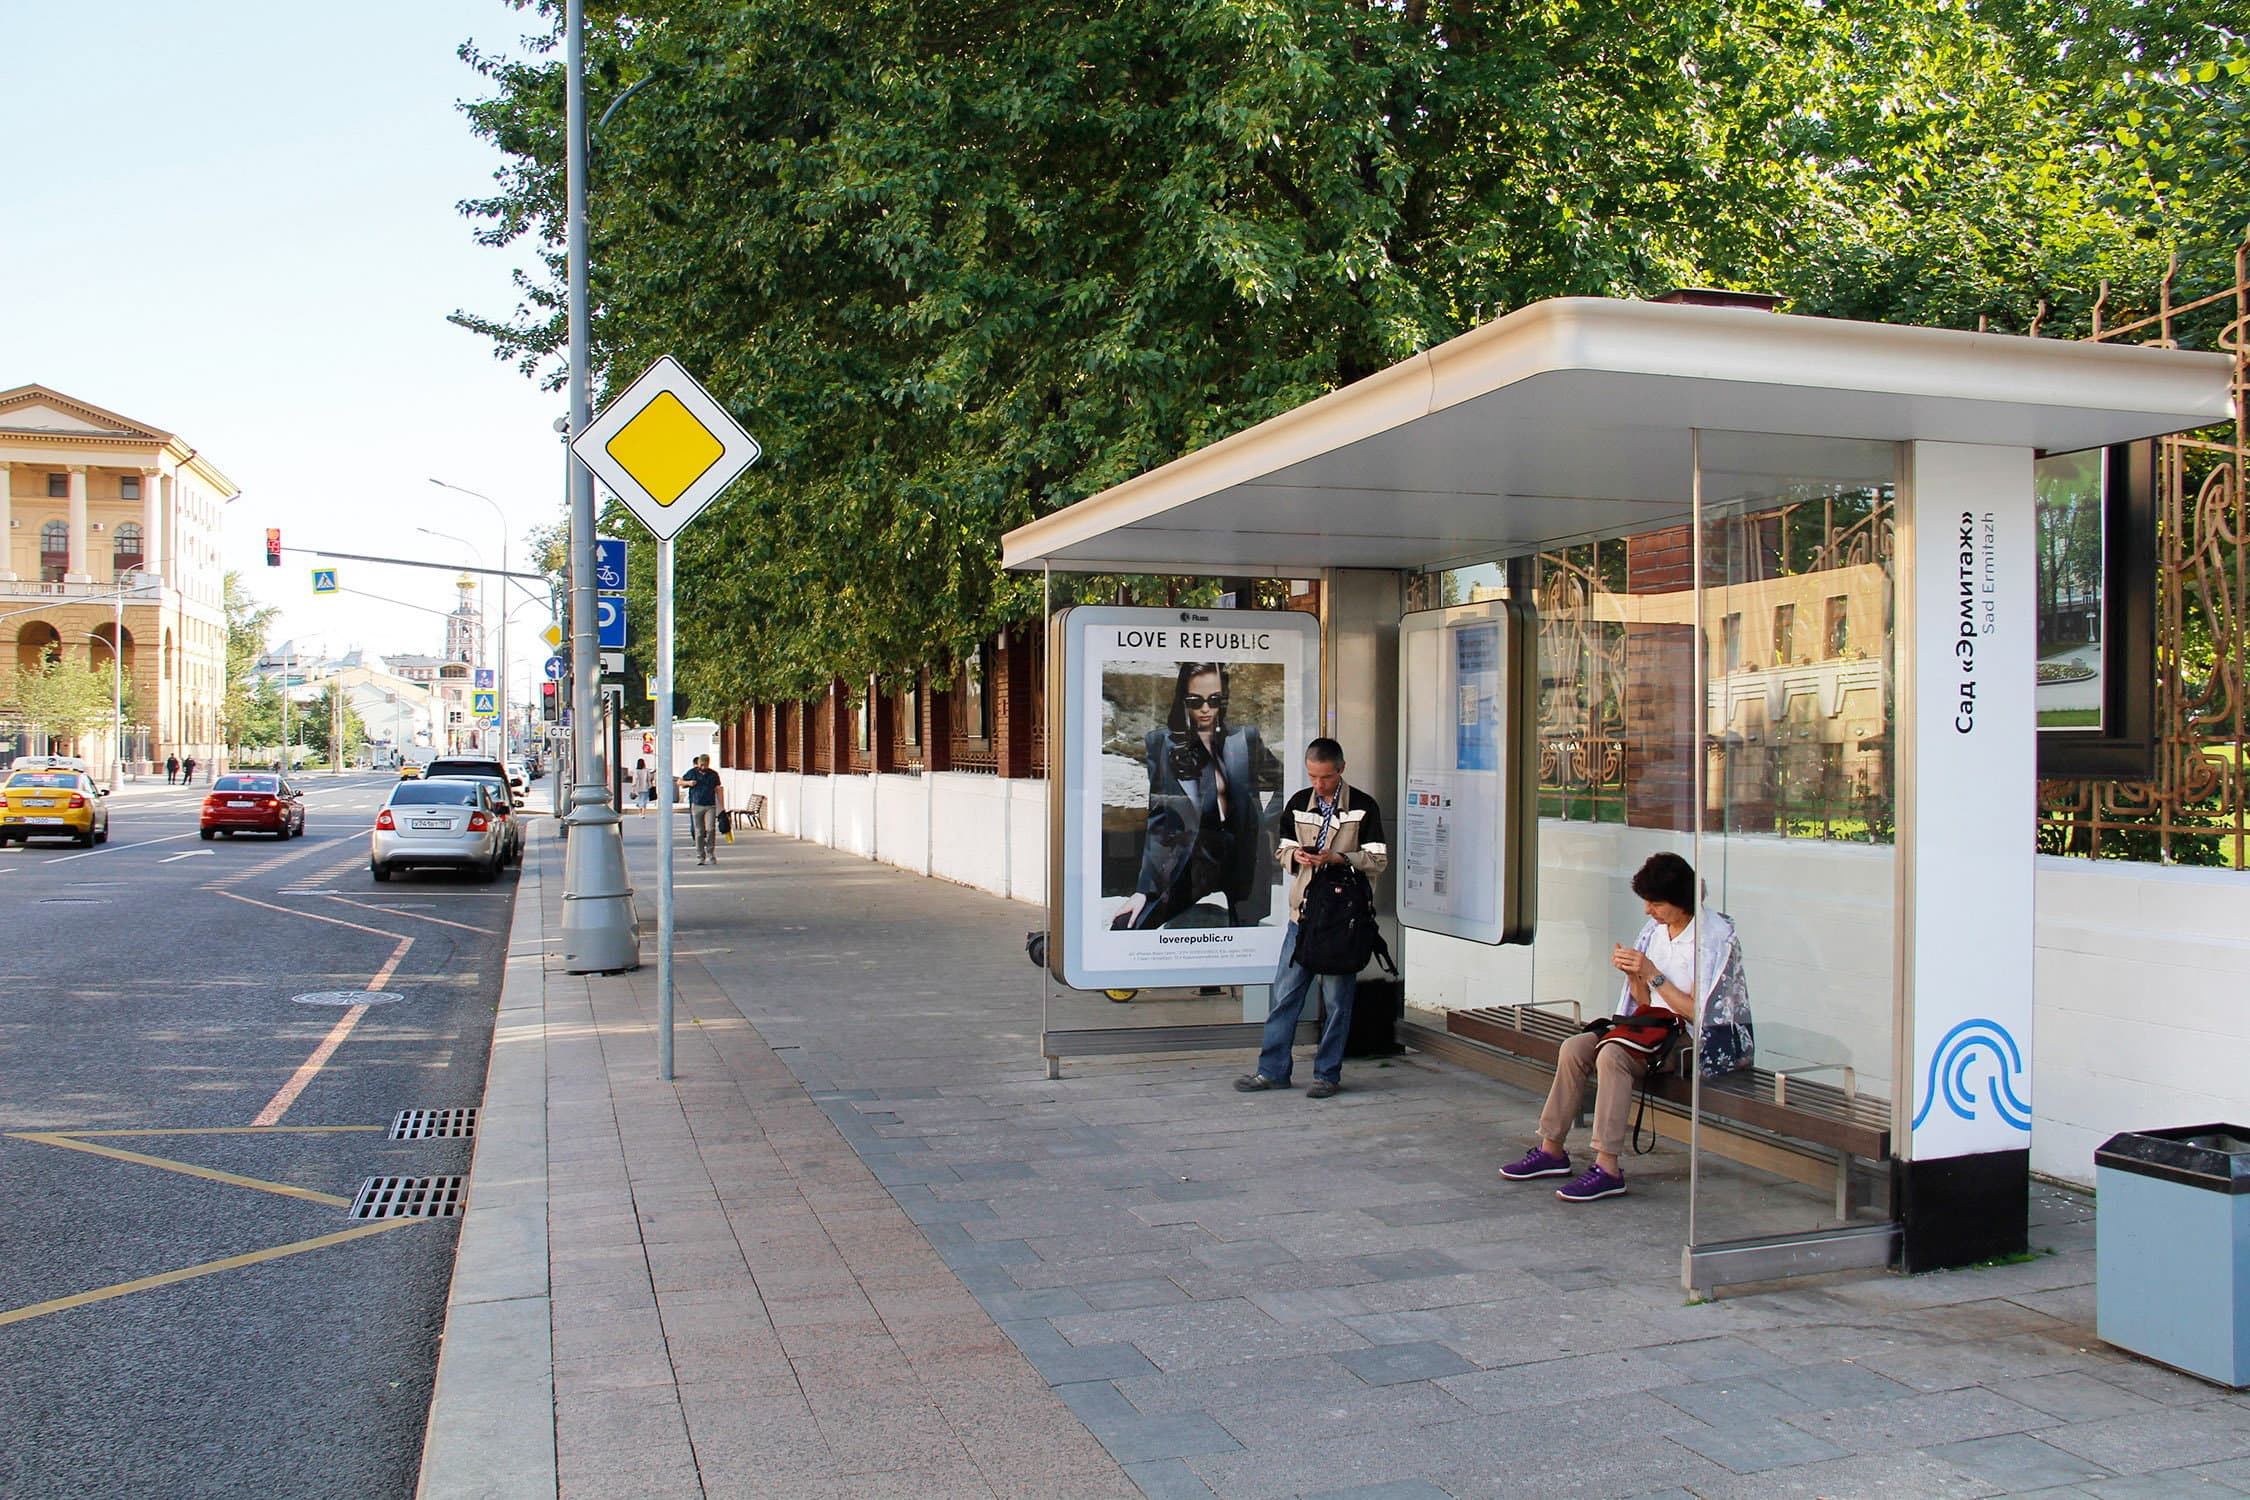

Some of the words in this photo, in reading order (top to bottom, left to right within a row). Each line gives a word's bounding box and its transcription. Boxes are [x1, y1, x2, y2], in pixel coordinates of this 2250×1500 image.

[1981, 512, 1995, 593] Ermitazh
[1955, 511, 1978, 673] «Эрмитаж»
[1982, 600, 1995, 634] Sad
[1117, 631, 1167, 648] LOVE
[1180, 632, 1270, 650] REPUBLIC
[1955, 681, 1977, 734] Сад
[1159, 933, 1234, 944] loverepublic.ru
